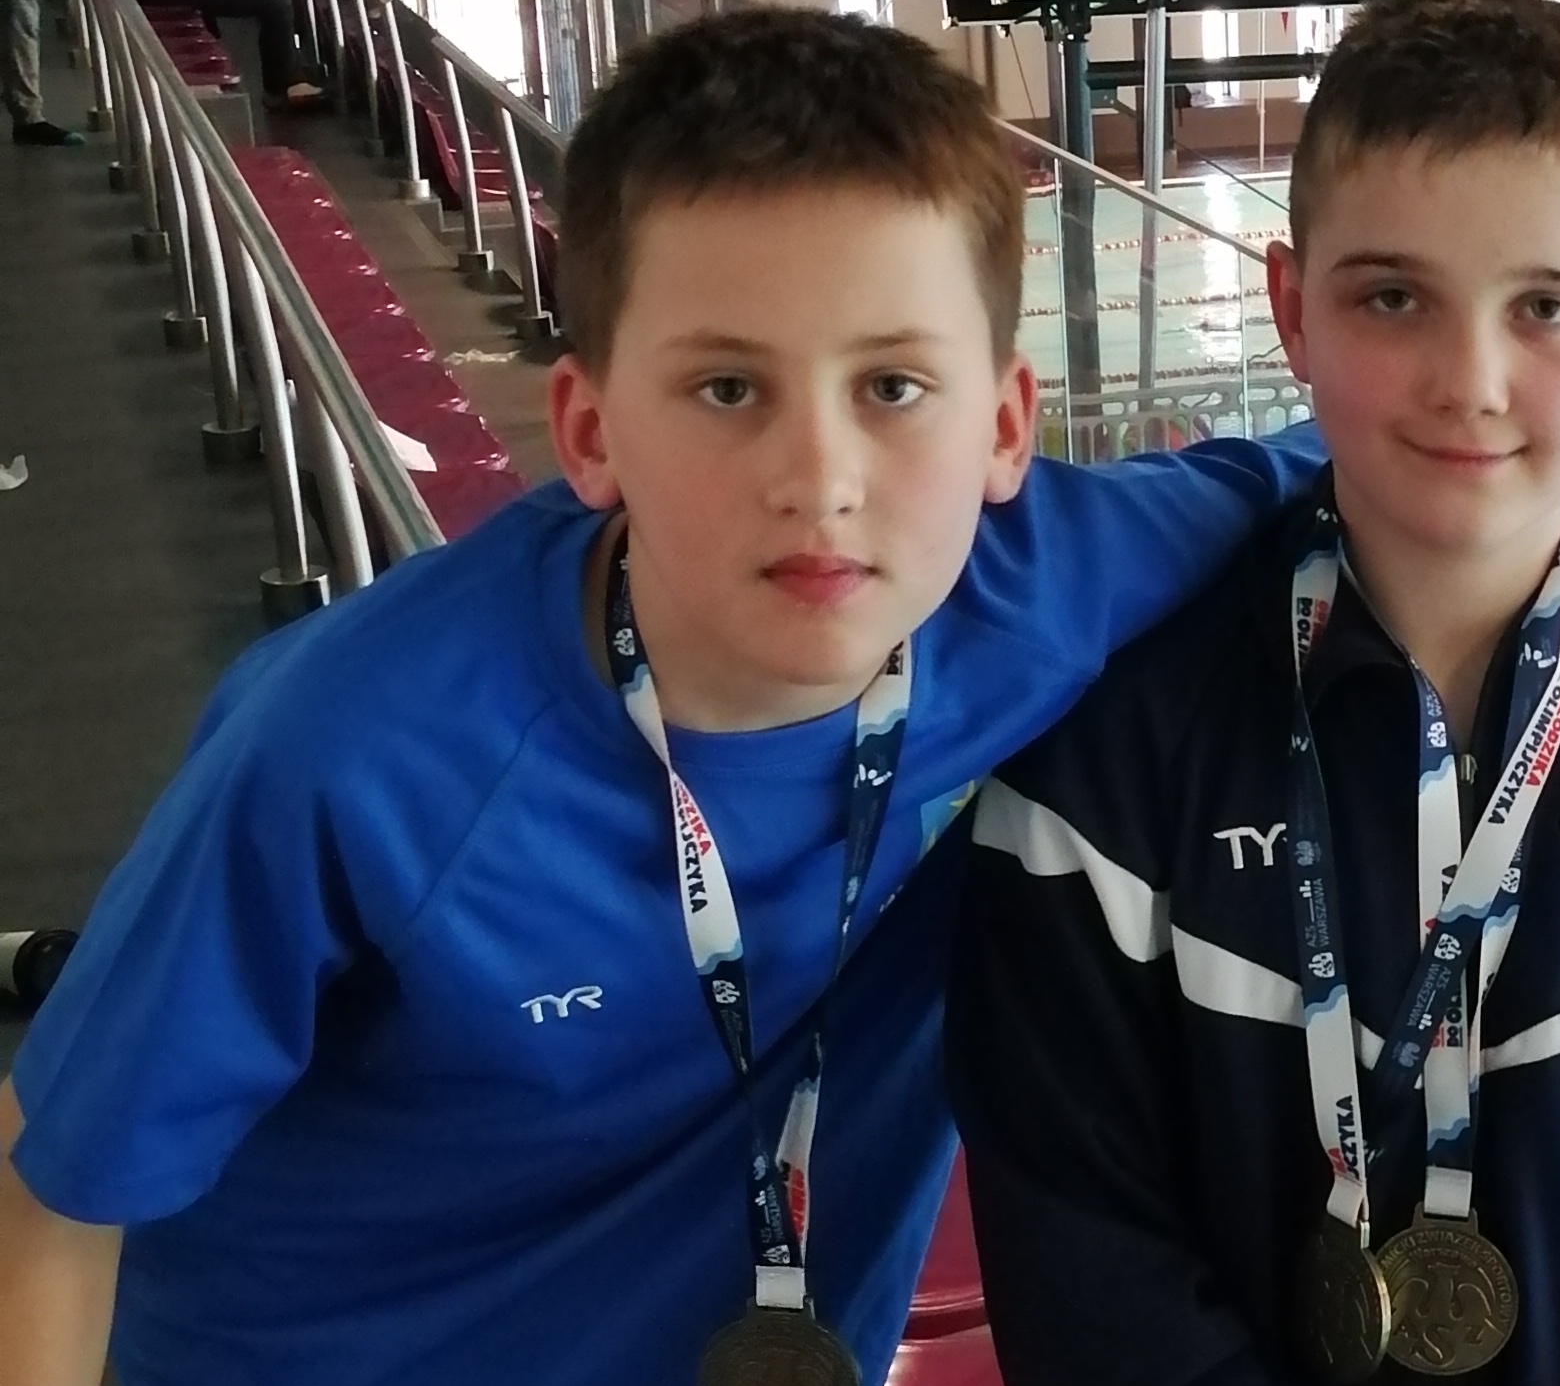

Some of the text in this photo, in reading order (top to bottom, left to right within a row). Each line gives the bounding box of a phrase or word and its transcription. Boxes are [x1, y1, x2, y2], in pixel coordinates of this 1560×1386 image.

[1212, 822, 1288, 870] TY
[520, 985, 603, 1024] TYR
[1379, 1235, 1417, 1271] MICKI
